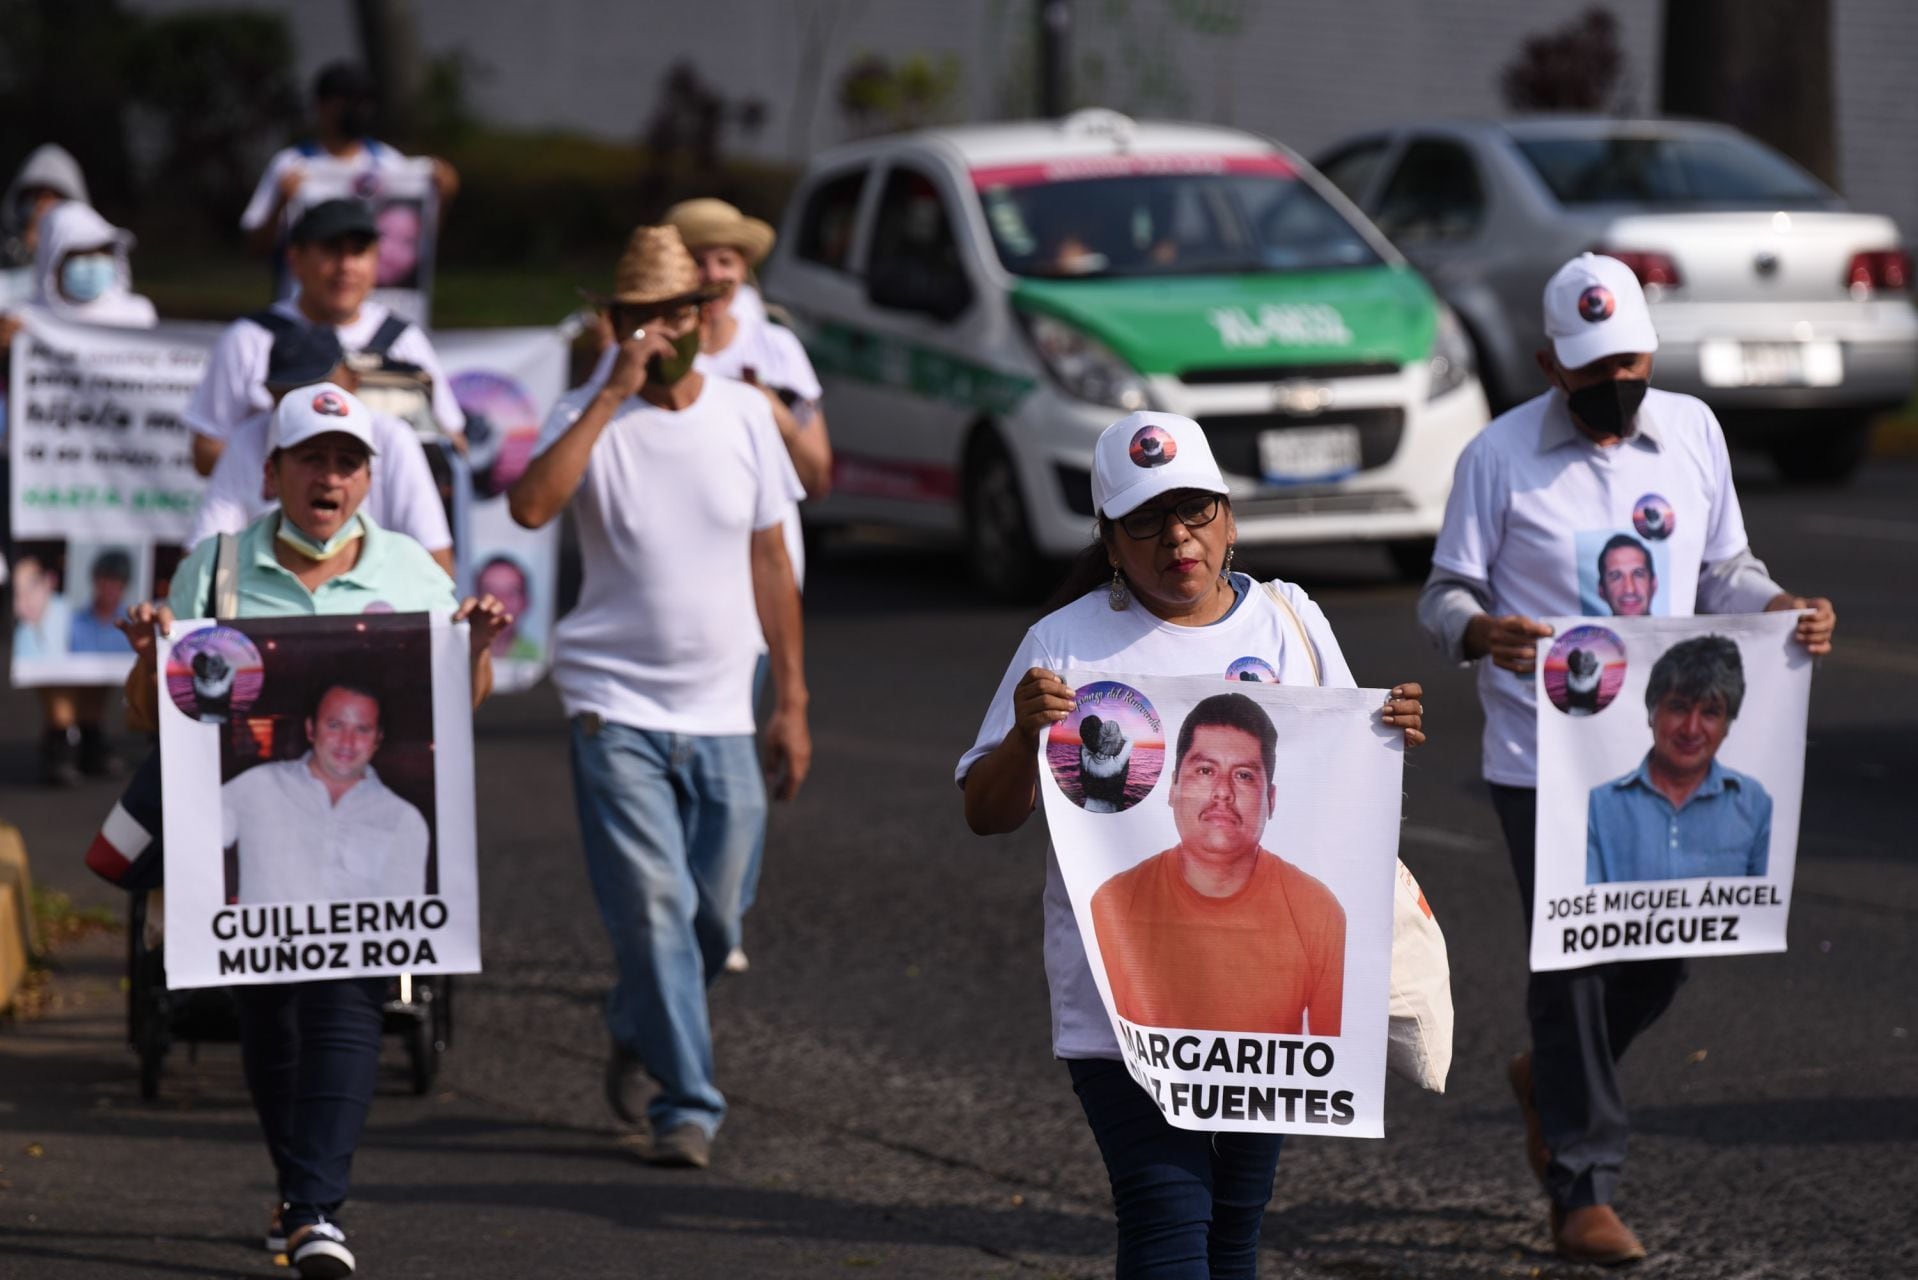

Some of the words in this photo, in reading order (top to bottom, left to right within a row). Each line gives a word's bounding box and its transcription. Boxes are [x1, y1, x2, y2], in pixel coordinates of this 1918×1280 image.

[212, 899, 448, 941] GUILLERMO
[1548, 889, 1597, 920] JOSÉ
[1604, 888, 1693, 912] MIGUEL
[1699, 880, 1783, 907] ÁNGEL
[1563, 912, 1740, 954] RODRÍGUEZ
[219, 935, 349, 975] MUÑOZ
[361, 938, 437, 968] ROA
[1119, 1020, 1335, 1078] MARGARITO
[1170, 1082, 1355, 1126] FUENTES
